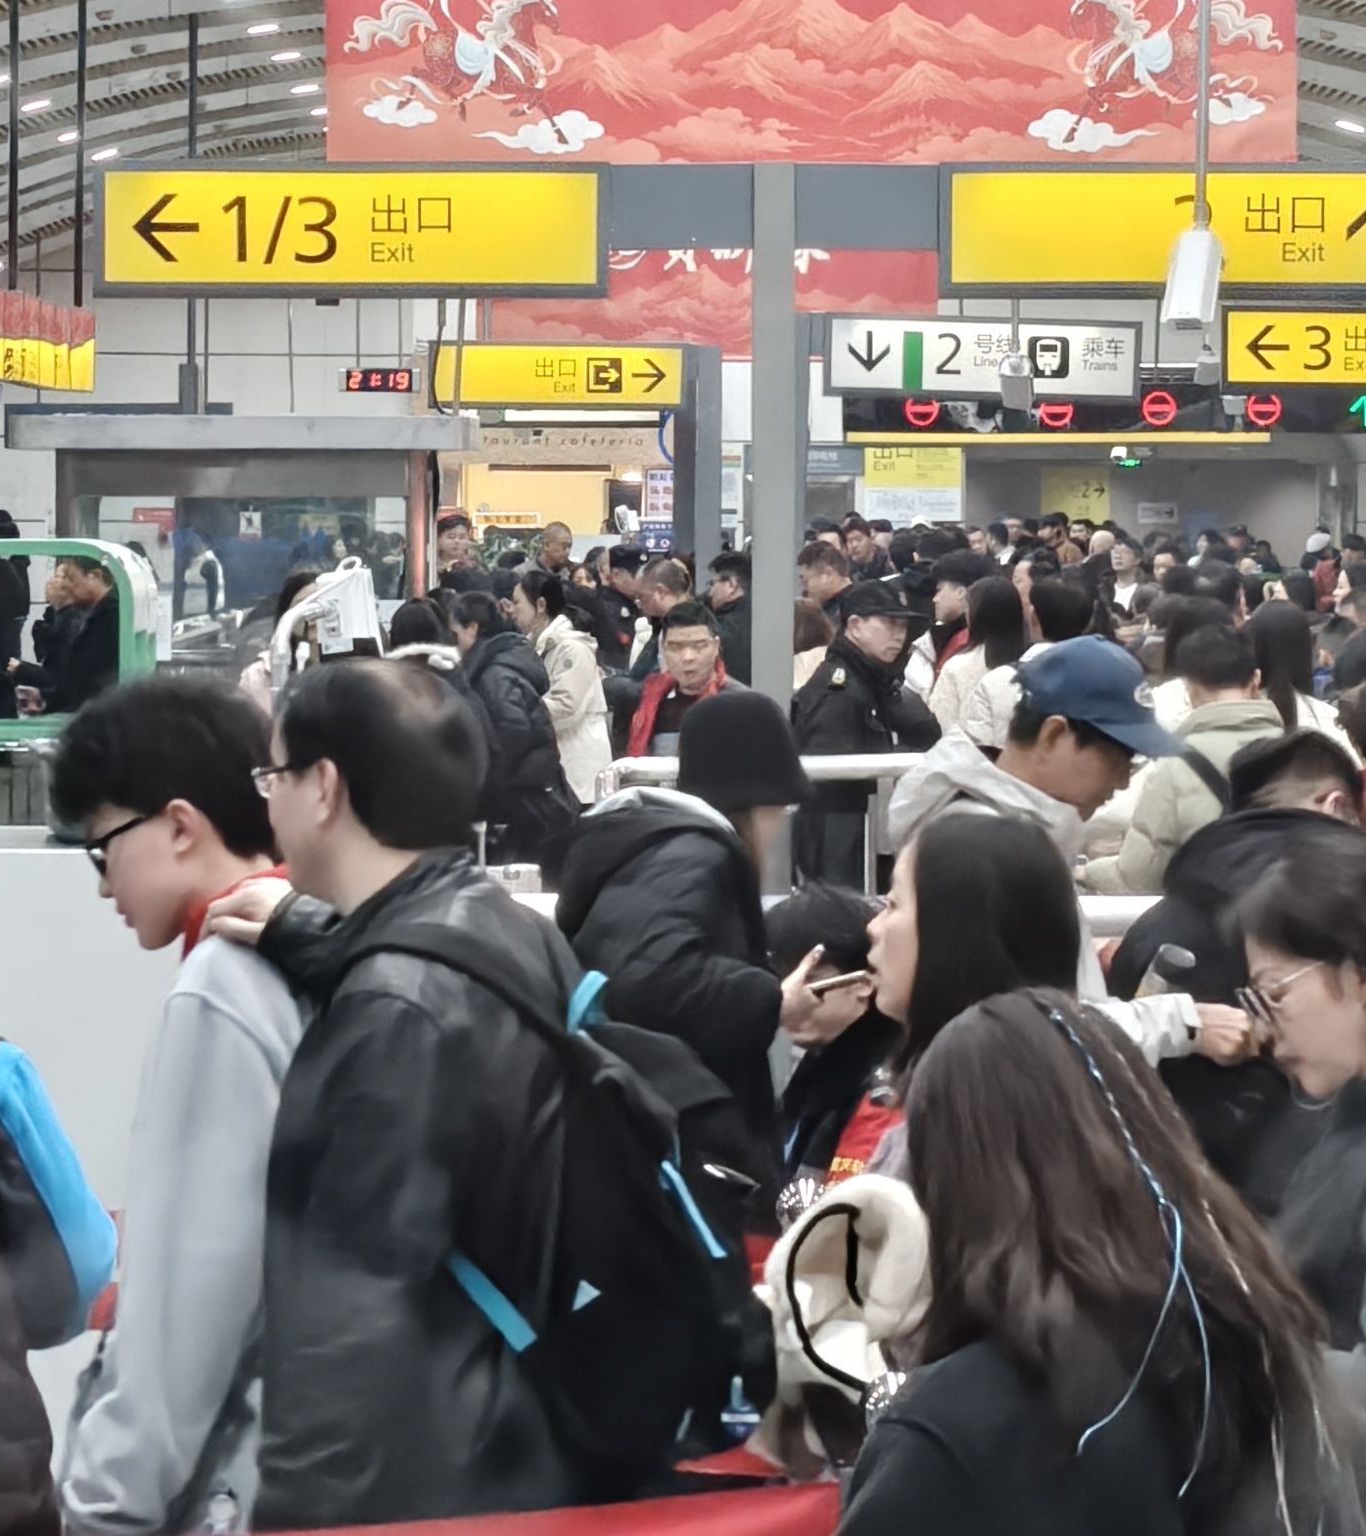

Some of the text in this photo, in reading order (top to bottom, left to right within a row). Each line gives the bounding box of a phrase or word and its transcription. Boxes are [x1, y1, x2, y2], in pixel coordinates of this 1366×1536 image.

[1245, 193, 1325, 233] 出口
[221, 194, 452, 265] 1/3 出口
[371, 242, 414, 263] Exit
[1282, 242, 1326, 263] Exit
[936, 332, 1015, 375] 2 号线
[1082, 337, 1125, 359] 乘车
[1304, 325, 1332, 370] 3
[535, 357, 576, 378] 出口
[973, 356, 998, 368] Line
[1081, 360, 1118, 372] Trains
[348, 371, 410, 390] 21:19
[554, 381, 576, 393] Exit
[561, 434, 643, 446] cafeteria
